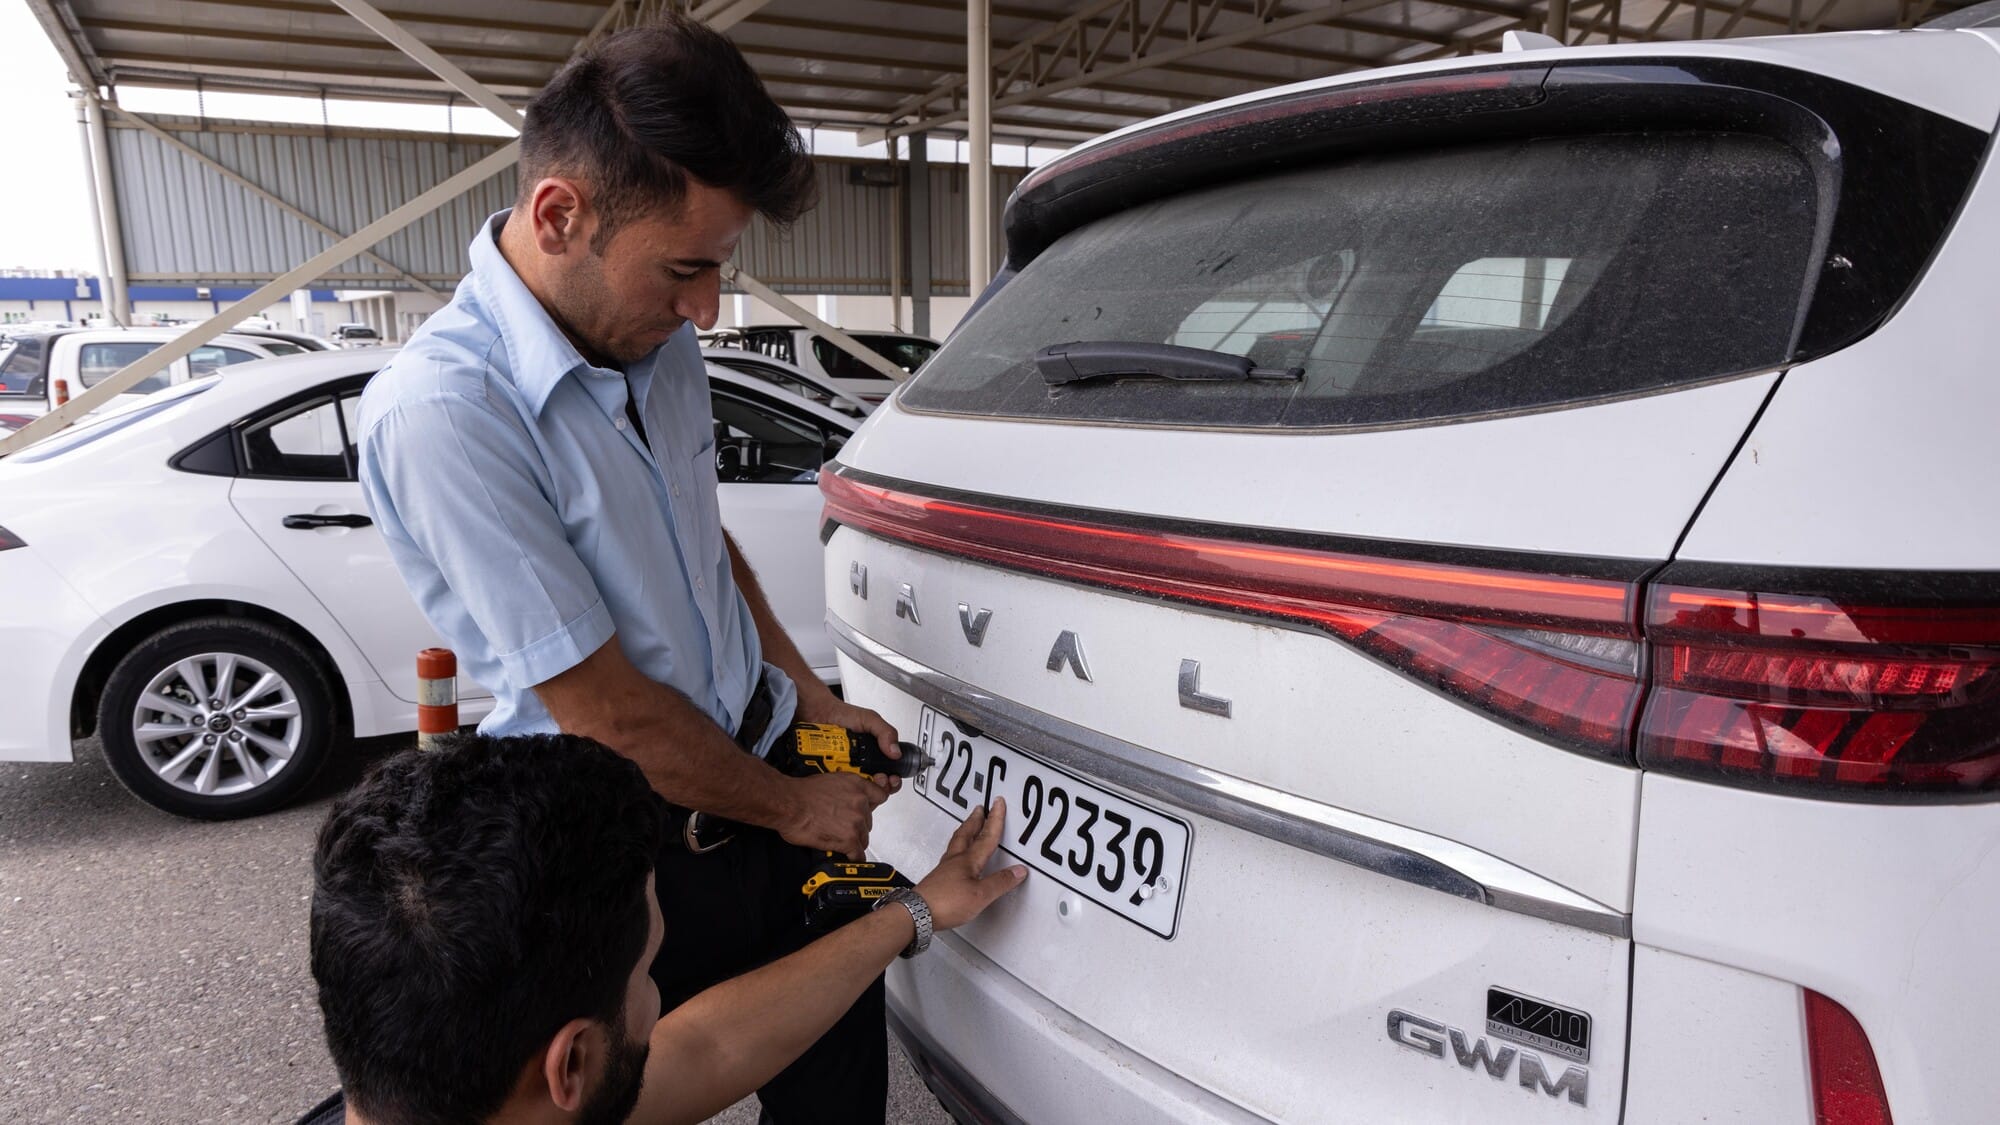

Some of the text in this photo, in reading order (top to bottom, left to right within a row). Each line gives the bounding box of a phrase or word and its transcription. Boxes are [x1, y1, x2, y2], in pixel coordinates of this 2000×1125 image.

[849, 560, 1233, 719] HAVAL
[1018, 775, 1164, 906] 92339
[1386, 1007, 1590, 1107] GWM
[1487, 1021, 1584, 1058] NAHJ AL IRAQ
